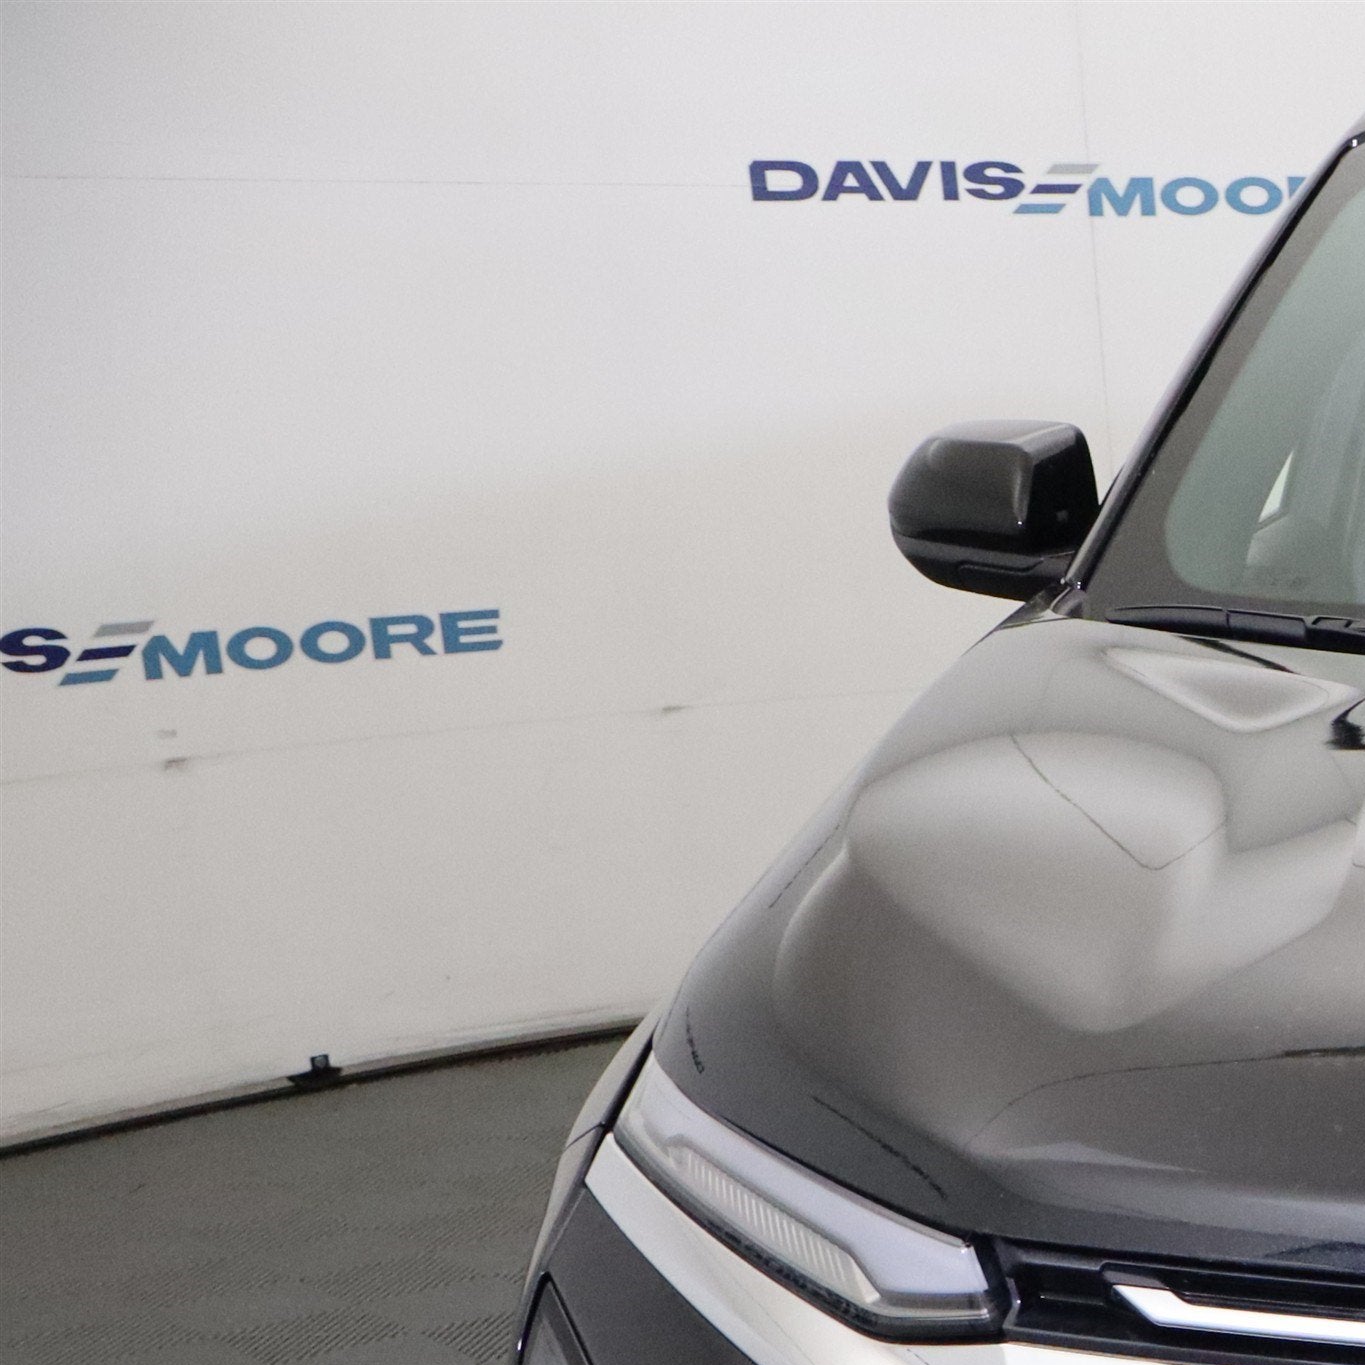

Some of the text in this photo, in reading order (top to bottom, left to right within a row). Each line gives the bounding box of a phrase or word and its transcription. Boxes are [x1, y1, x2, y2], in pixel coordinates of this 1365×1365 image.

[749, 160, 1307, 216] DAVIS MOO
[141, 609, 504, 681] MOORE
